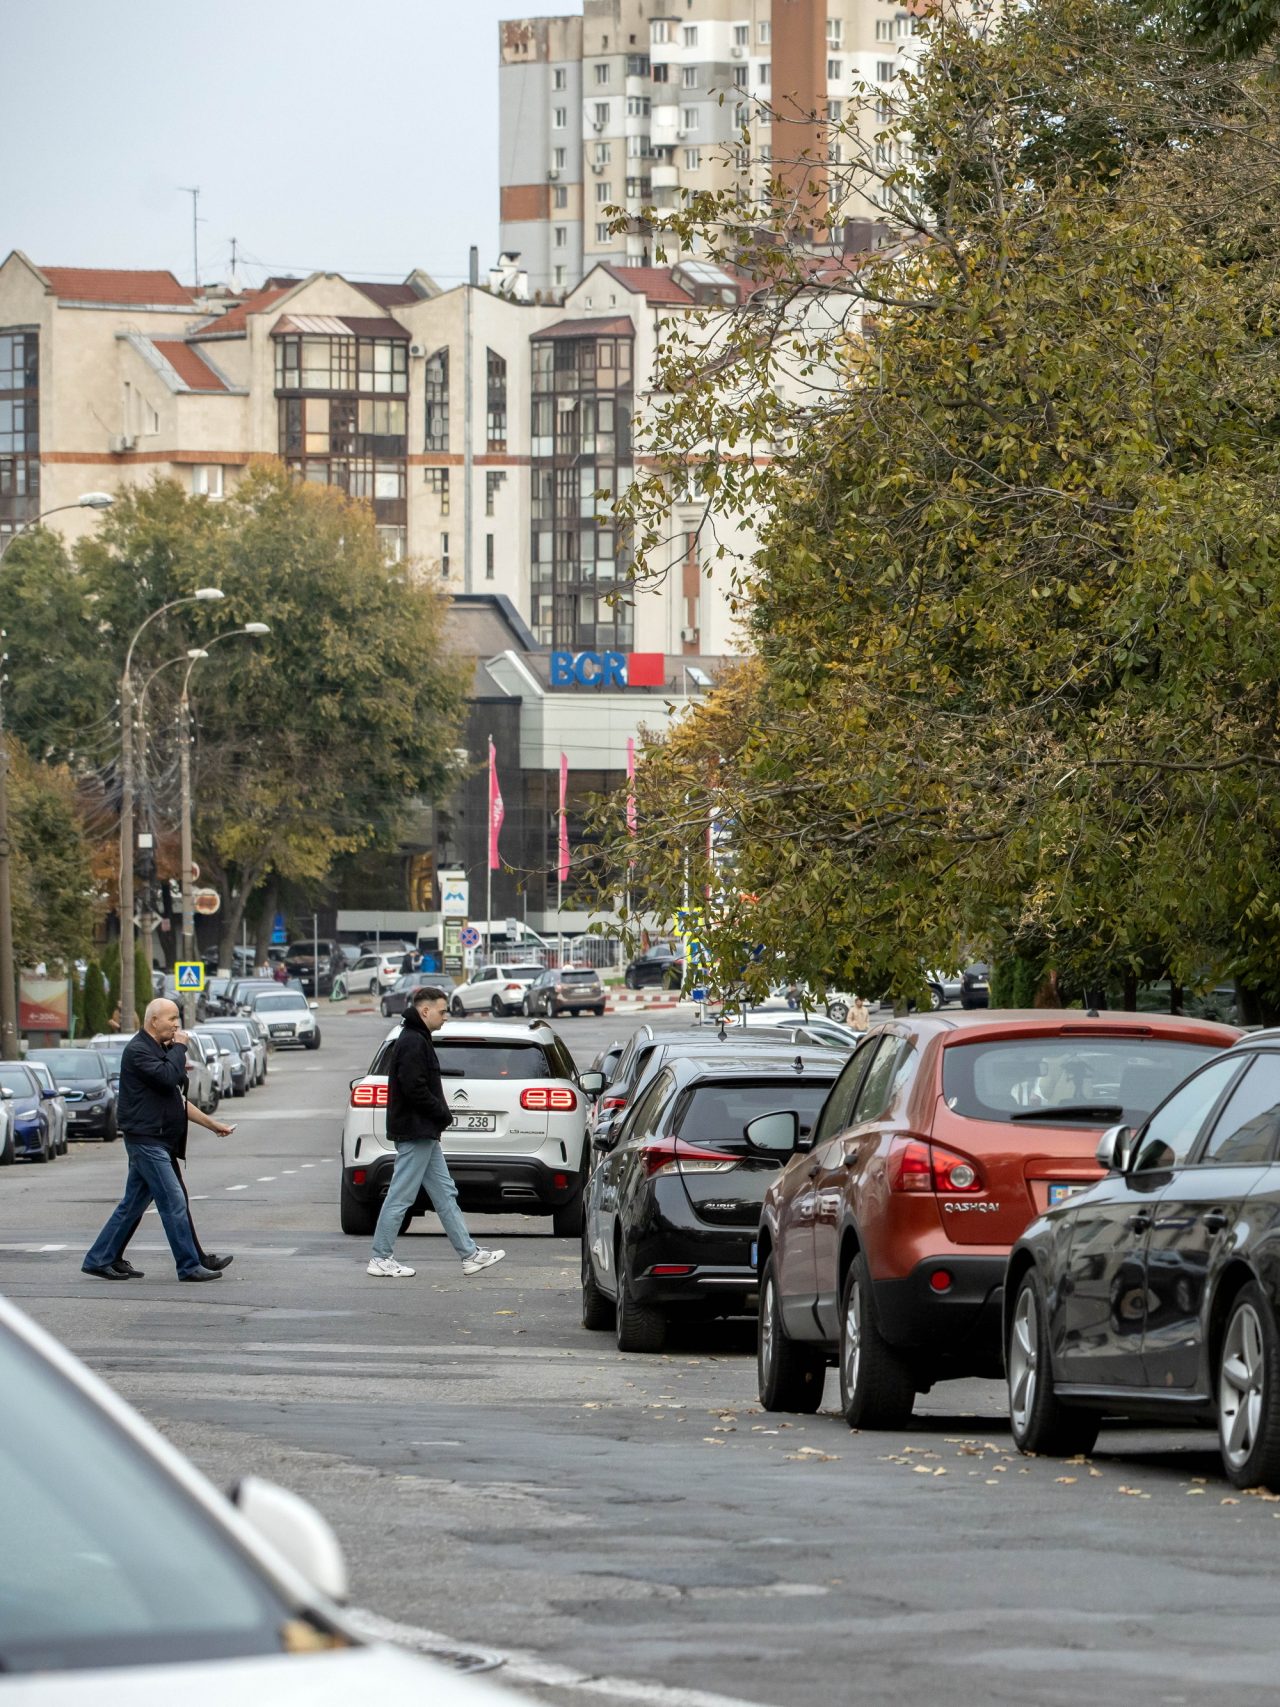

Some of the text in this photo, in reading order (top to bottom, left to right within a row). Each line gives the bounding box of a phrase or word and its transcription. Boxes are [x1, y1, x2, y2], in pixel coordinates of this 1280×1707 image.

[550, 650, 628, 688] BCR
[468, 1116, 489, 1128] 238
[944, 1202, 1000, 1213] QASHQAI
